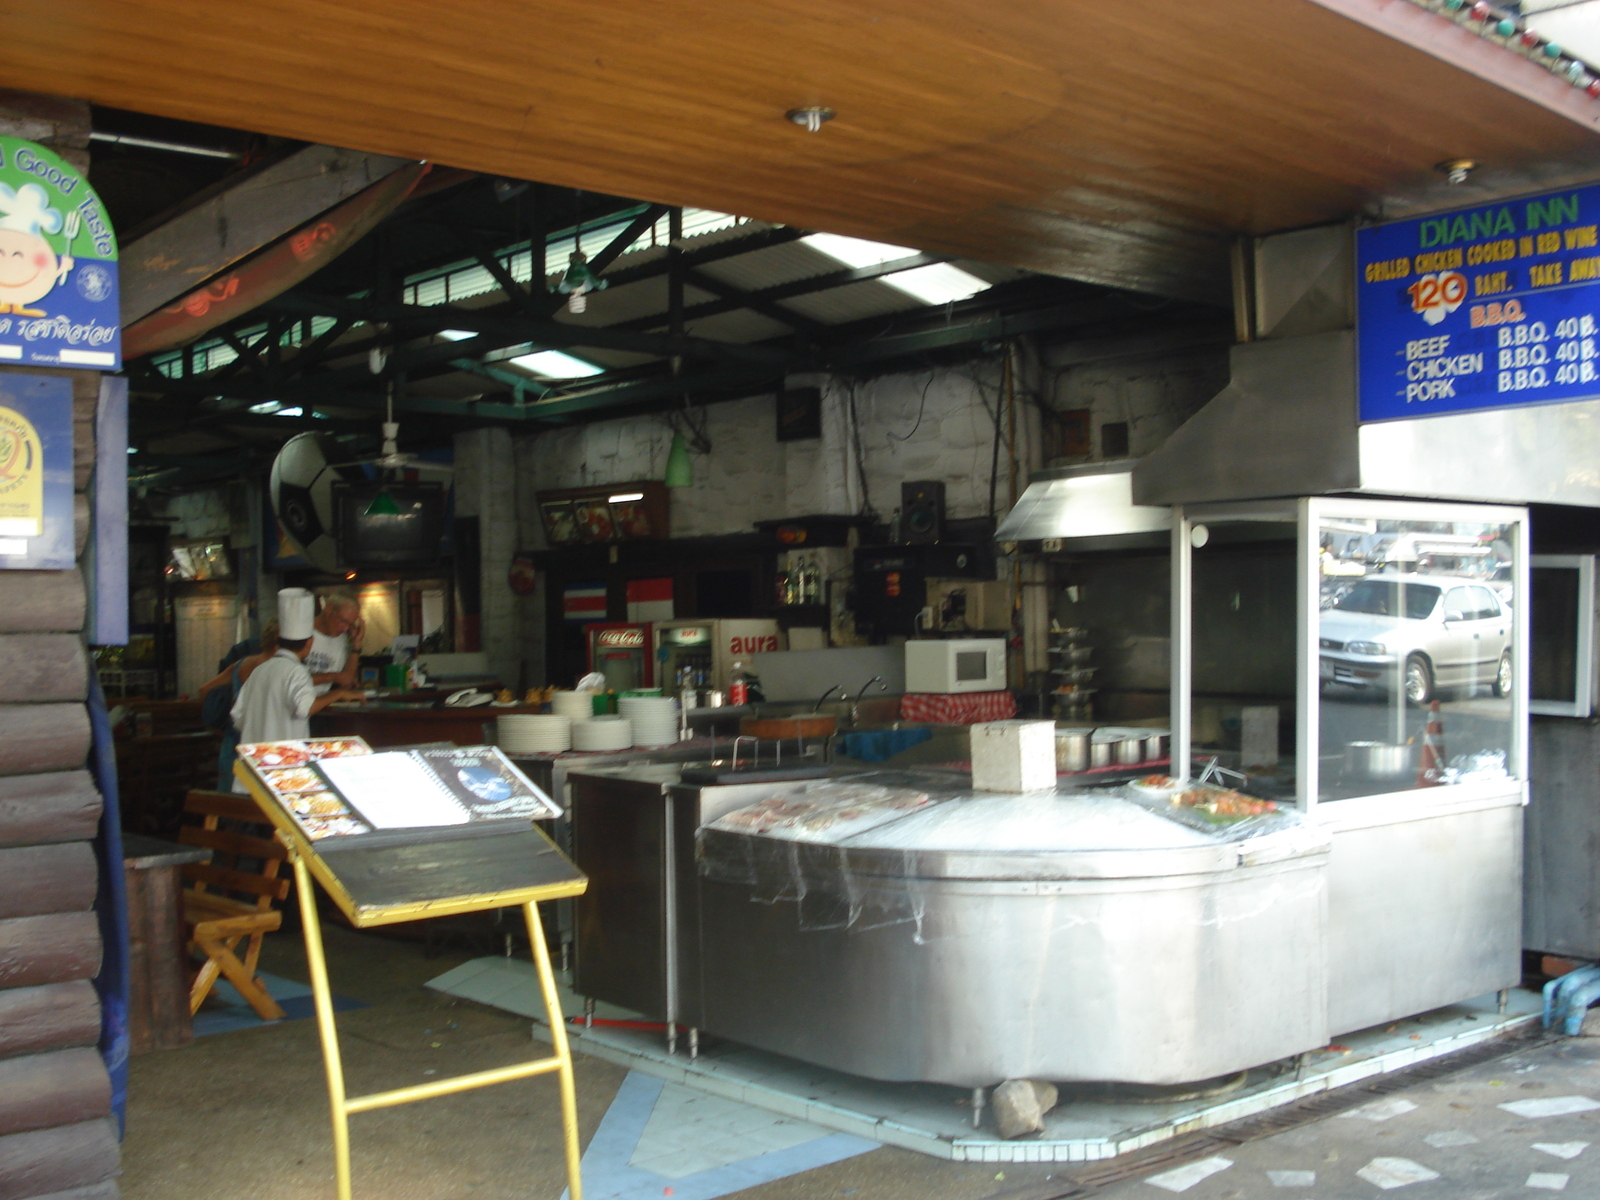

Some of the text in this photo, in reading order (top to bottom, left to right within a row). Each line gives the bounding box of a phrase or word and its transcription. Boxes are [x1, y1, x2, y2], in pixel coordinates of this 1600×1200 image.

[14, 146, 80, 195] Good
[77, 189, 114, 258] Taste
[1419, 194, 1579, 248] DIANA INN
[1364, 225, 1599, 283] GRILLED CHICKEN COOKED IN RED WINE
[1529, 261, 1563, 288] TAKE
[1406, 271, 1469, 315] 120
[1405, 334, 1451, 362] BEEF
[1405, 352, 1484, 382] CHICKEN
[1405, 377, 1457, 404] PORK
[730, 633, 778, 655] aura
